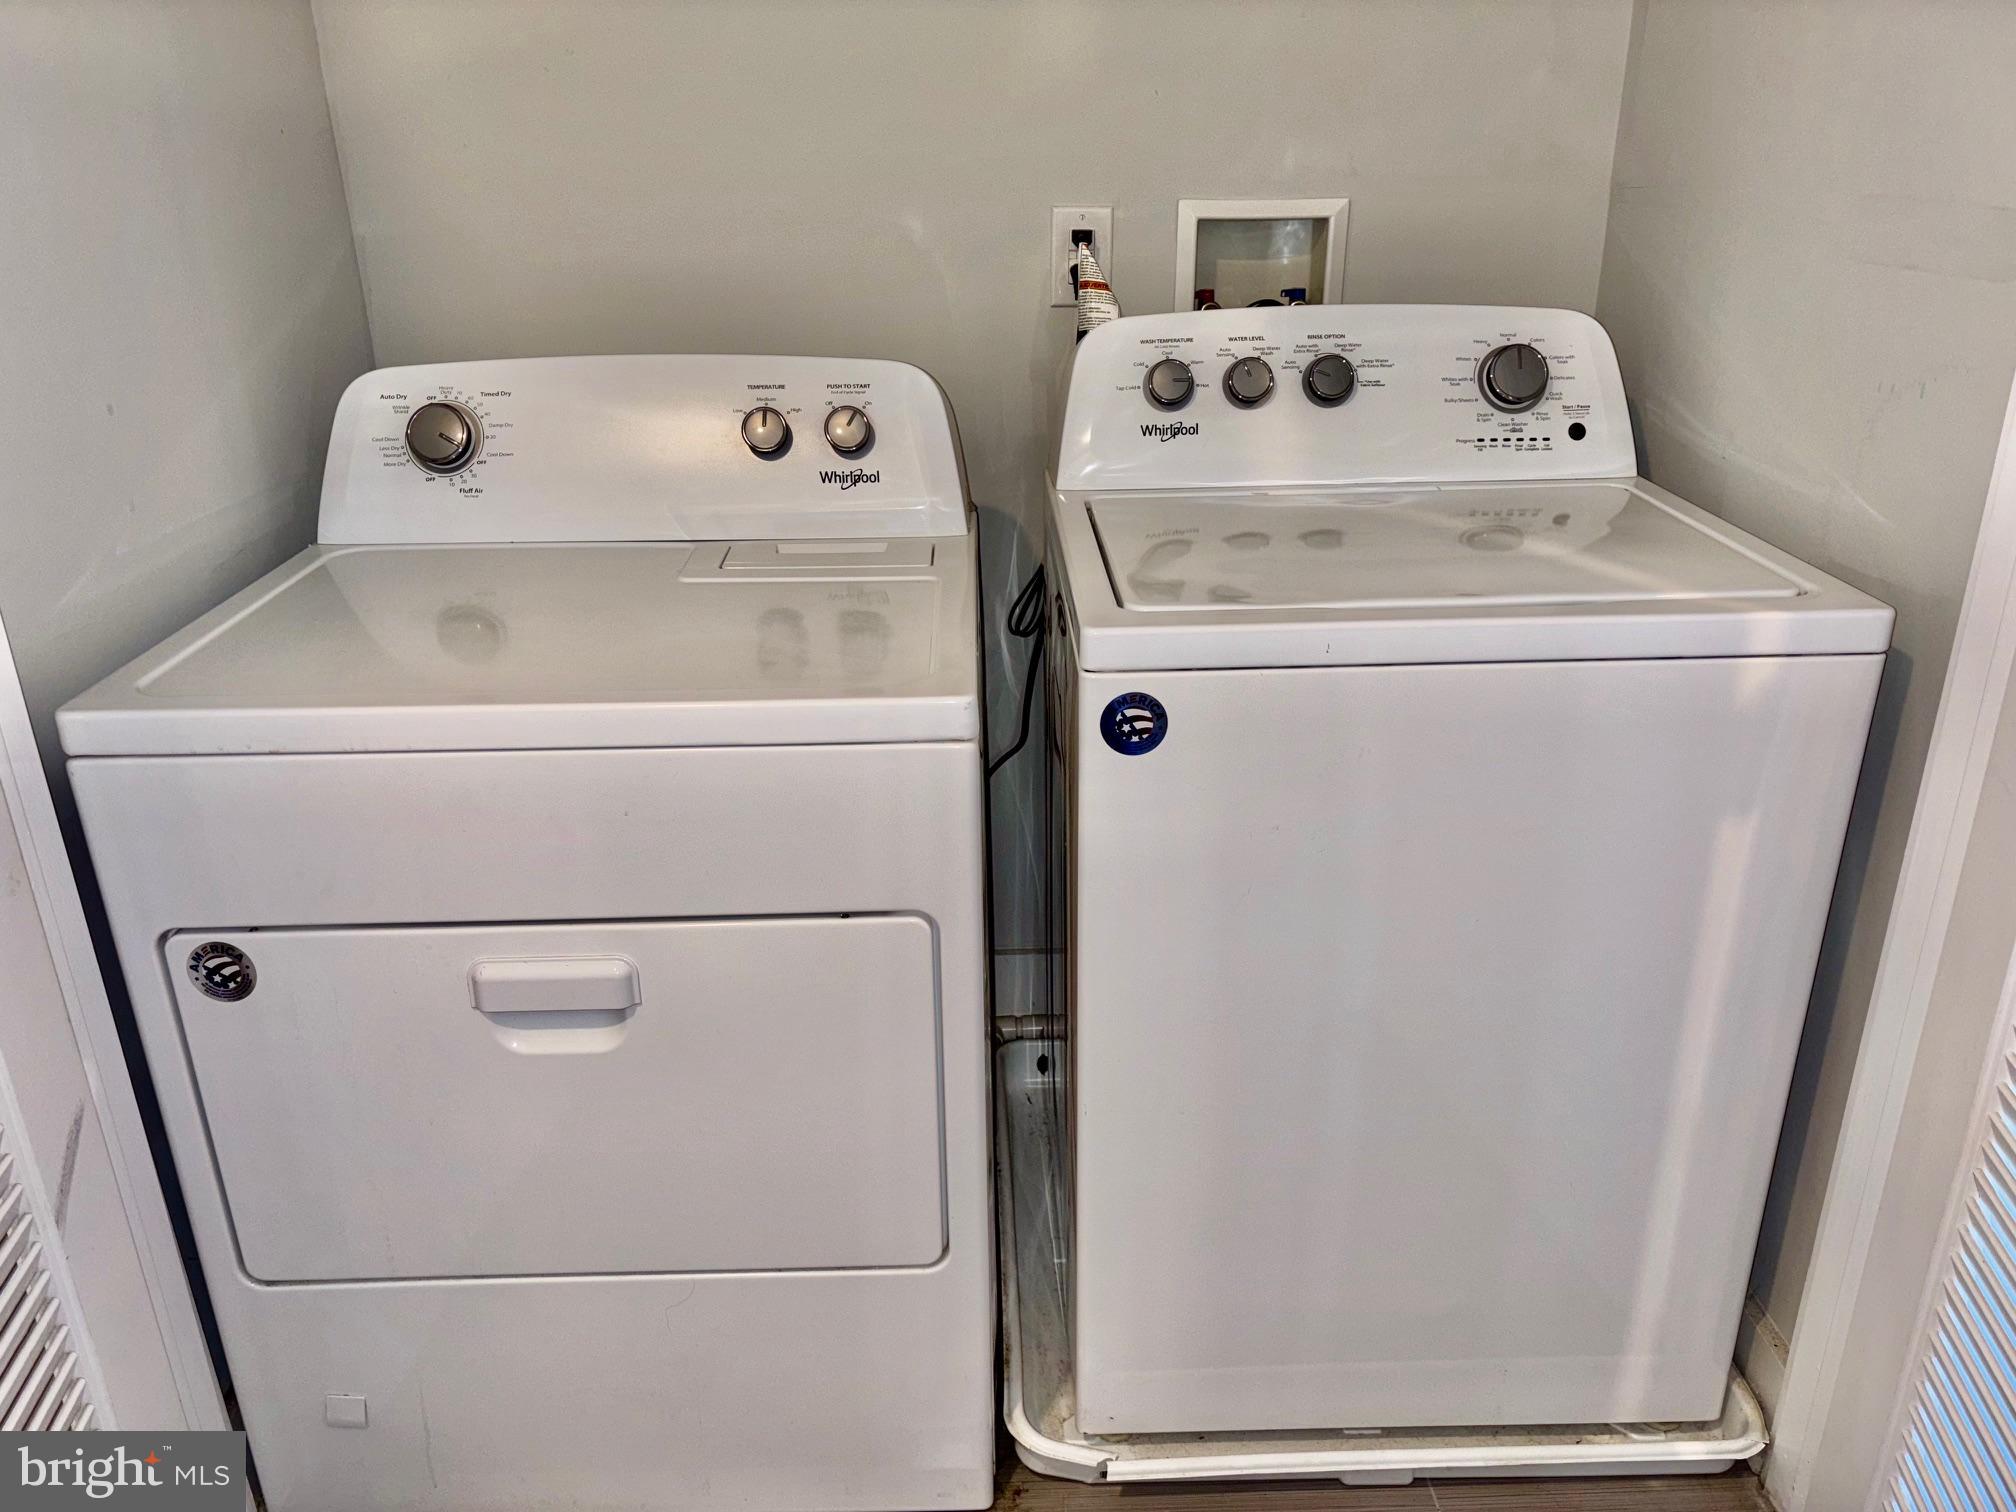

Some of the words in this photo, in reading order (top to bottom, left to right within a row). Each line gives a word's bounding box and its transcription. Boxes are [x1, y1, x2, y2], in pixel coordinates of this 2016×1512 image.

[1140, 422, 1198, 441] Whirlpool
[819, 470, 880, 489] Whirlpool
[1110, 694, 1165, 721] MERICA
[189, 944, 243, 972] AMERICA
